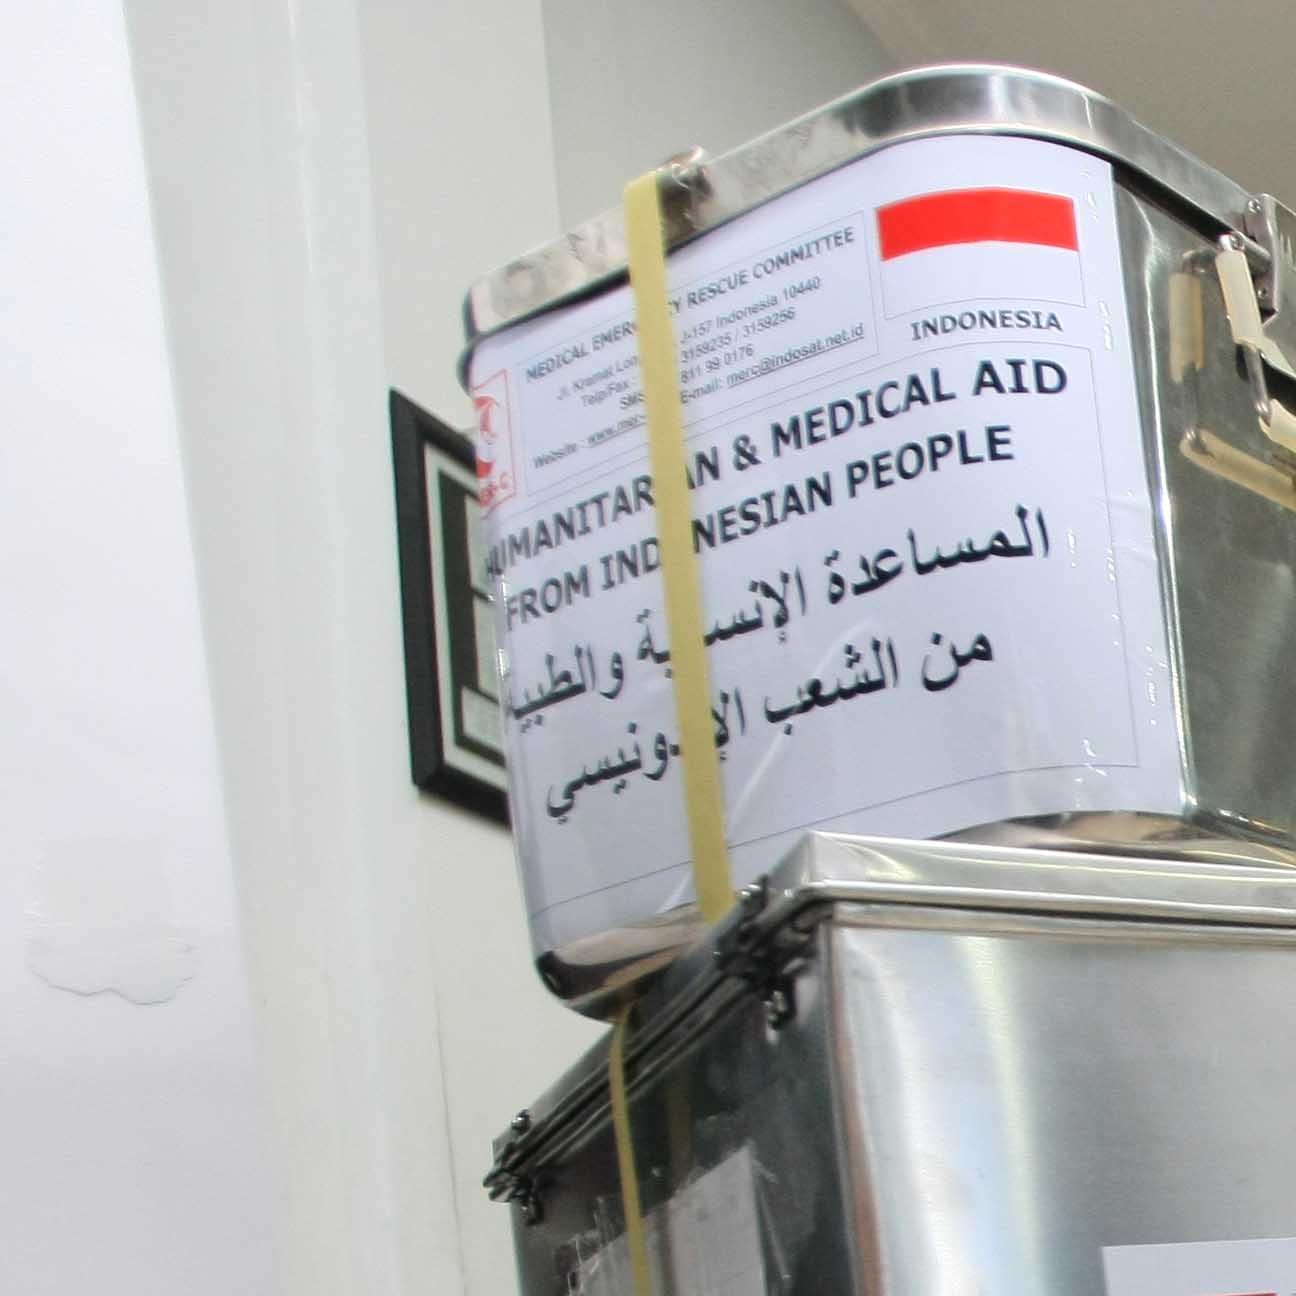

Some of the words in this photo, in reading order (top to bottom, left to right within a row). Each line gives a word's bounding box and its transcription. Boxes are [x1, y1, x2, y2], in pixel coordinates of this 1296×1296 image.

[526, 343, 588, 381] MEDICAL
[687, 269, 748, 307] RESCUE
[753, 226, 855, 279] COMMITTEE
[716, 295, 779, 327] Indonesia
[783, 276, 821, 300] 10440
[911, 310, 1063, 340] INDONESIA
[681, 332, 732, 363] 3159235
[743, 307, 796, 337] 3159256
[724, 344, 754, 365] 0176
[727, 322, 864, 387] merc@indosat.net.id
[732, 433, 762, 472] &
[770, 367, 957, 457] MEDICAL
[972, 358, 1068, 396] AID
[507, 564, 590, 631] FROM
[600, 471, 833, 590] INDNESIAN
[845, 425, 1015, 499] PEOPLE
[824, 502, 1050, 605] المساعدة
[764, 636, 899, 736] الشعب
[922, 631, 993, 692] من
